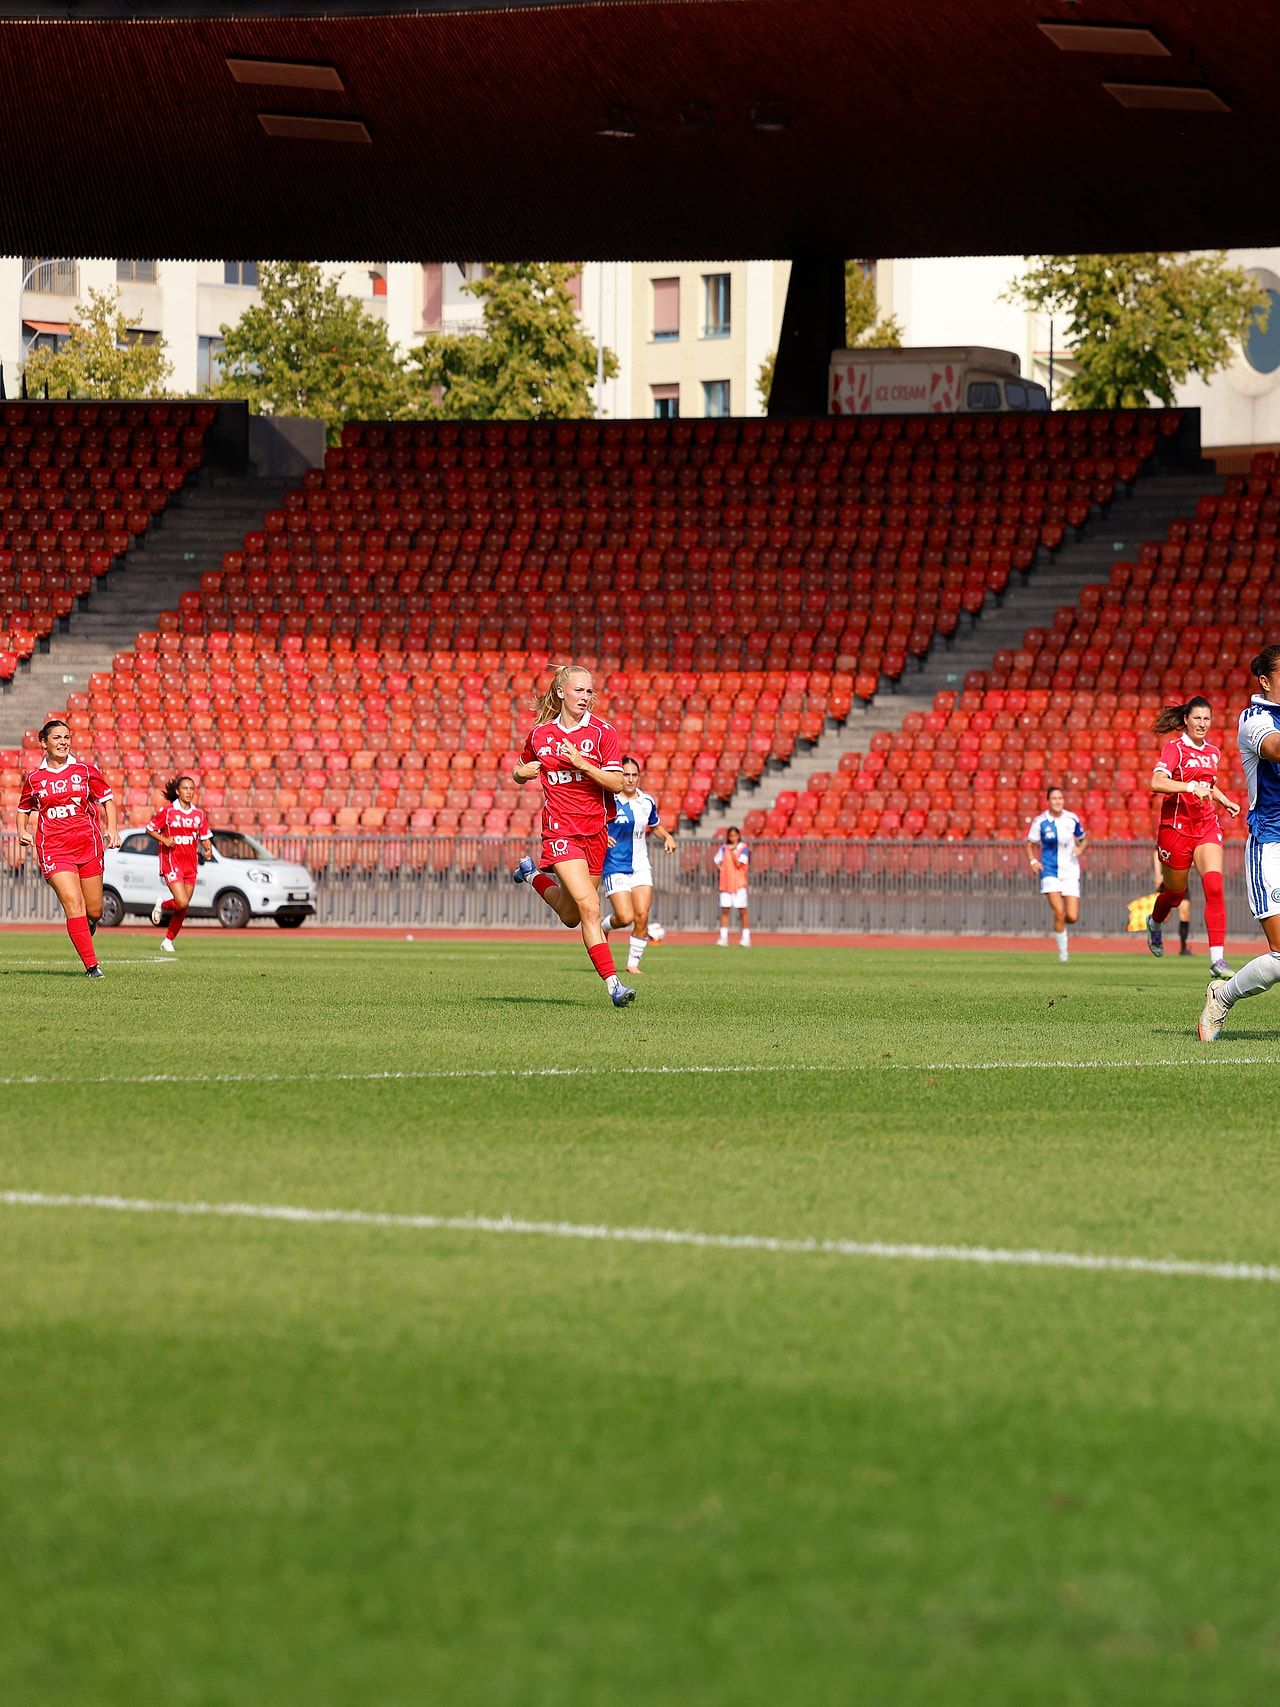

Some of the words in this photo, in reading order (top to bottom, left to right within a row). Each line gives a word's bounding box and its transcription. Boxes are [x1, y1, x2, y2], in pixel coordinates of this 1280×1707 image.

[875, 384, 889, 401] ICE
[891, 384, 926, 401] CREAM
[47, 804, 77, 819] OBT
[174, 836, 193, 845] OBT
